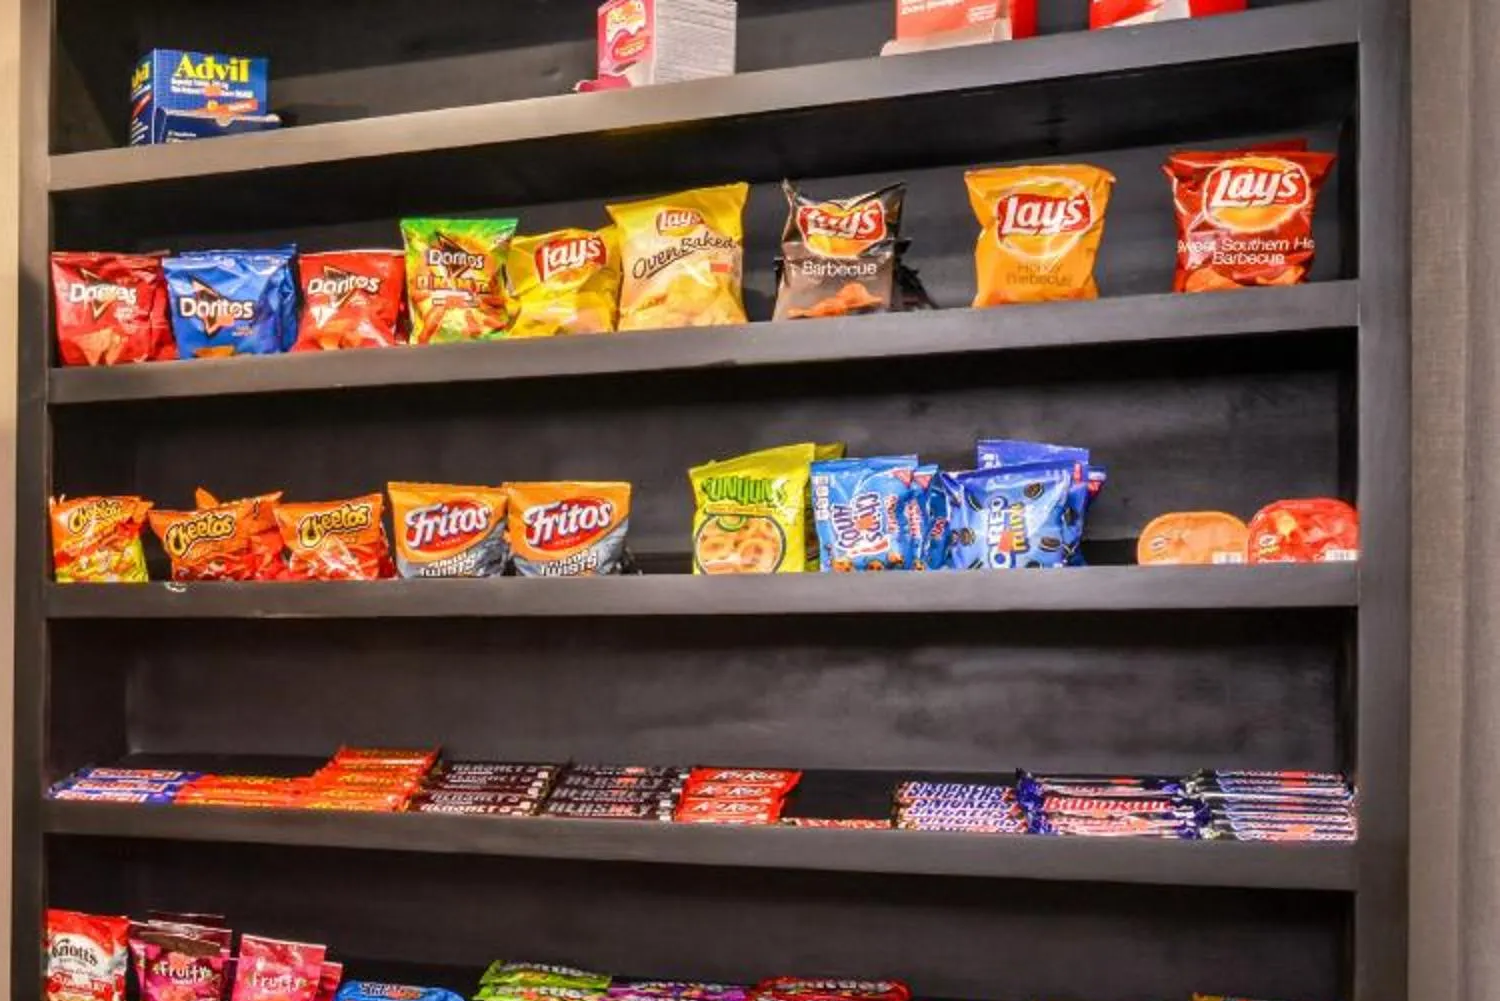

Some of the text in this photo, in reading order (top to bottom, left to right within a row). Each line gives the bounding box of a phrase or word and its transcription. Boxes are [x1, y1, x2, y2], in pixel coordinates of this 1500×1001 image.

[173, 53, 250, 83] Advil
[631, 234, 734, 280] Oven Baked
[1221, 237, 1289, 251] Southern
[802, 261, 877, 276] Barbecue
[1212, 252, 1285, 265] Barbecue
[70, 281, 138, 306] Doritos
[306, 275, 382, 297] Doritos
[178, 296, 255, 321] Doritos
[163, 509, 236, 558] Cheetos
[298, 502, 374, 550] Cheetos
[404, 500, 492, 549] Fritos
[523, 497, 614, 547] Fritos
